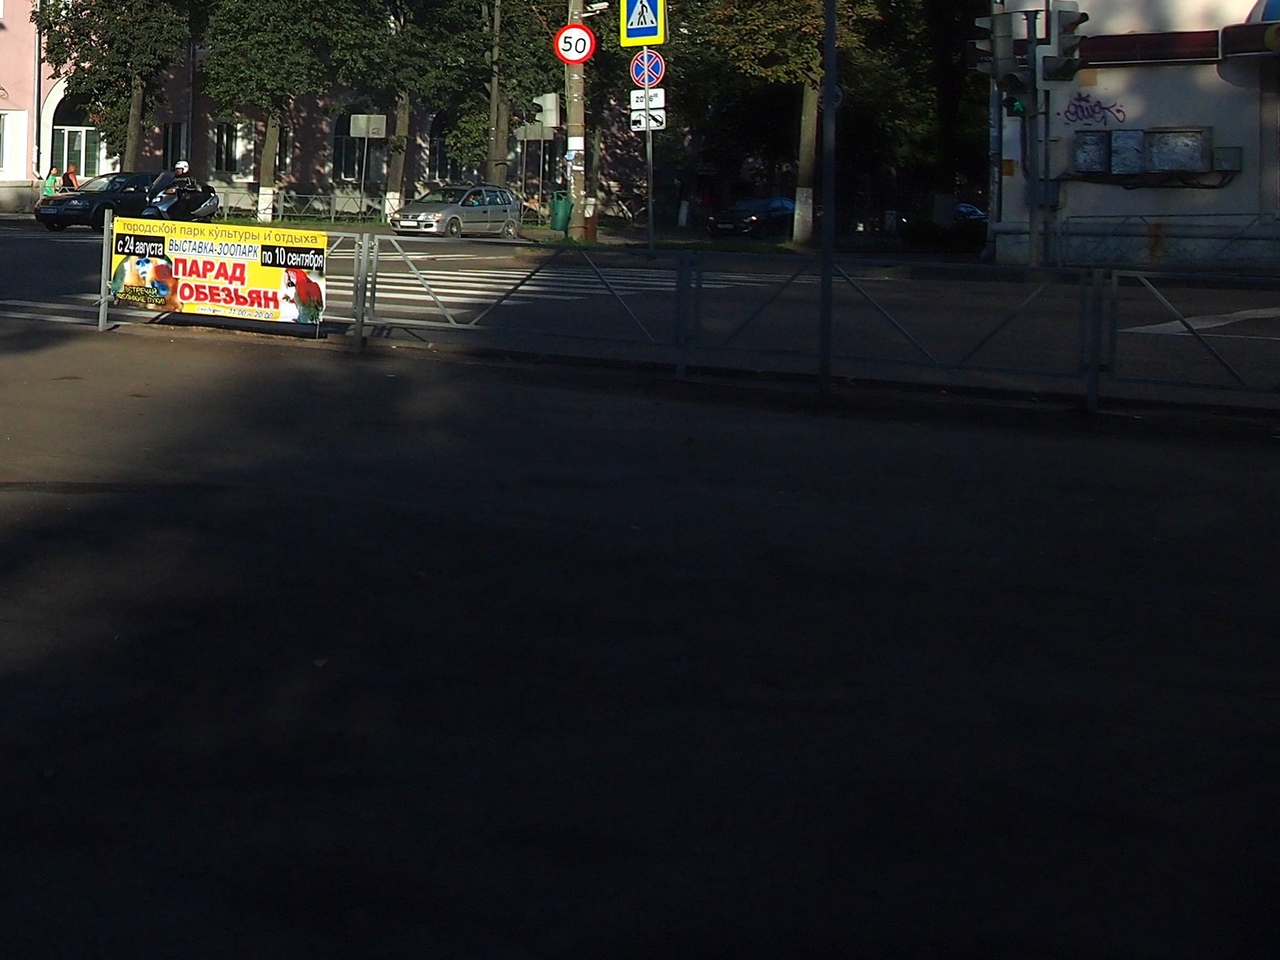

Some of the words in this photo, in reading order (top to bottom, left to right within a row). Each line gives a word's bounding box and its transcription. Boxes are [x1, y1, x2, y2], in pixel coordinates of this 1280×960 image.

[561, 36, 587, 53] 50
[123, 222, 176, 234] городской
[180, 226, 205, 237] парк
[208, 227, 260, 241] культуры
[263, 231, 271, 239] и
[274, 233, 318, 244] отдыха
[117, 240, 123, 252] с
[124, 236, 134, 253] 24
[135, 241, 163, 258] августа
[168, 239, 259, 258] ВЫСТАВКА-ЗООПАРК
[262, 250, 273, 264] по
[275, 247, 286, 265] 10
[287, 250, 323, 270] сентября
[174, 258, 246, 286] ПАРАД
[179, 282, 280, 310] ОБЕЗЬЯН
